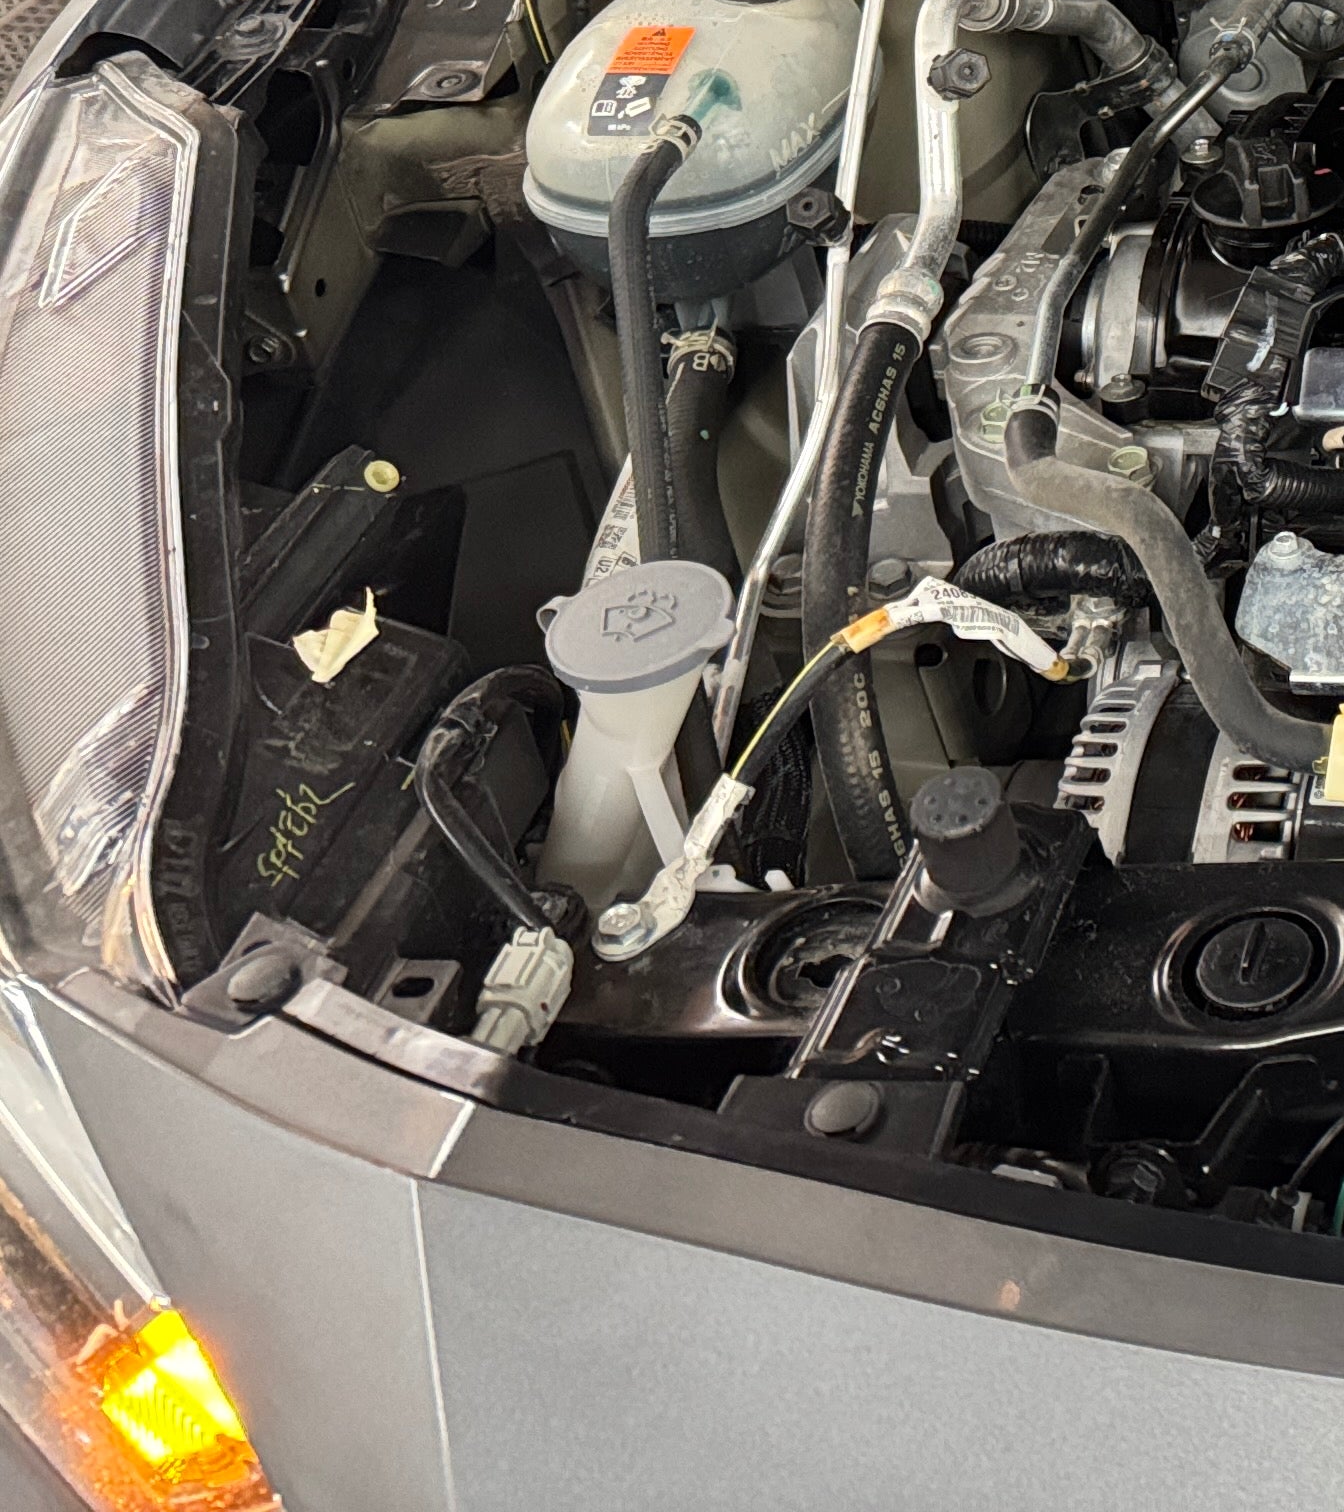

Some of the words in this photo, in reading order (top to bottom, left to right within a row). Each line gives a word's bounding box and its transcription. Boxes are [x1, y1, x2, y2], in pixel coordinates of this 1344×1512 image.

[769, 112, 823, 178] MAX
[853, 441, 876, 501] YOKOHAMA
[892, 343, 907, 361] 15
[868, 749, 884, 781] 15
